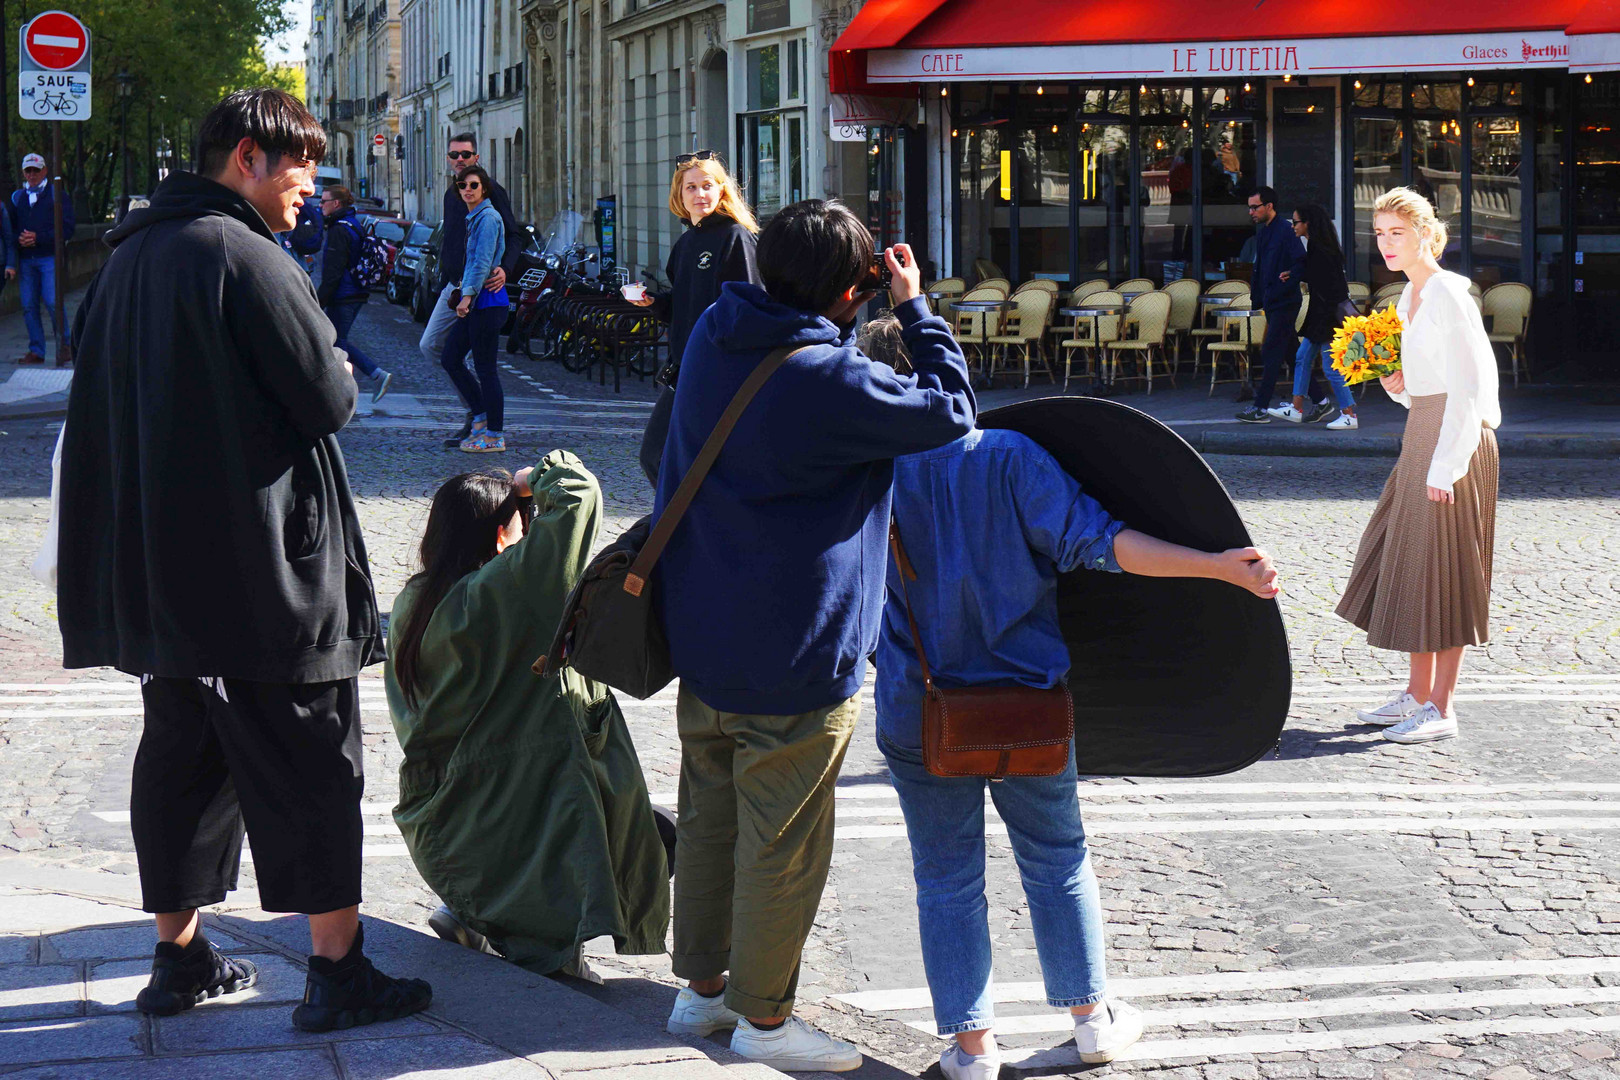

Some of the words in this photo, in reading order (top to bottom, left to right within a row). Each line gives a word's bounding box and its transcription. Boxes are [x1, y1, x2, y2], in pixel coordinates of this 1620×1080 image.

[1173, 49, 1198, 72] LE
[1208, 47, 1300, 71] LUTETIA
[1462, 45, 1508, 59] Glaces
[1521, 38, 1570, 63] Berthil
[921, 54, 964, 72] CAFE
[37, 75, 75, 87] SAUF
